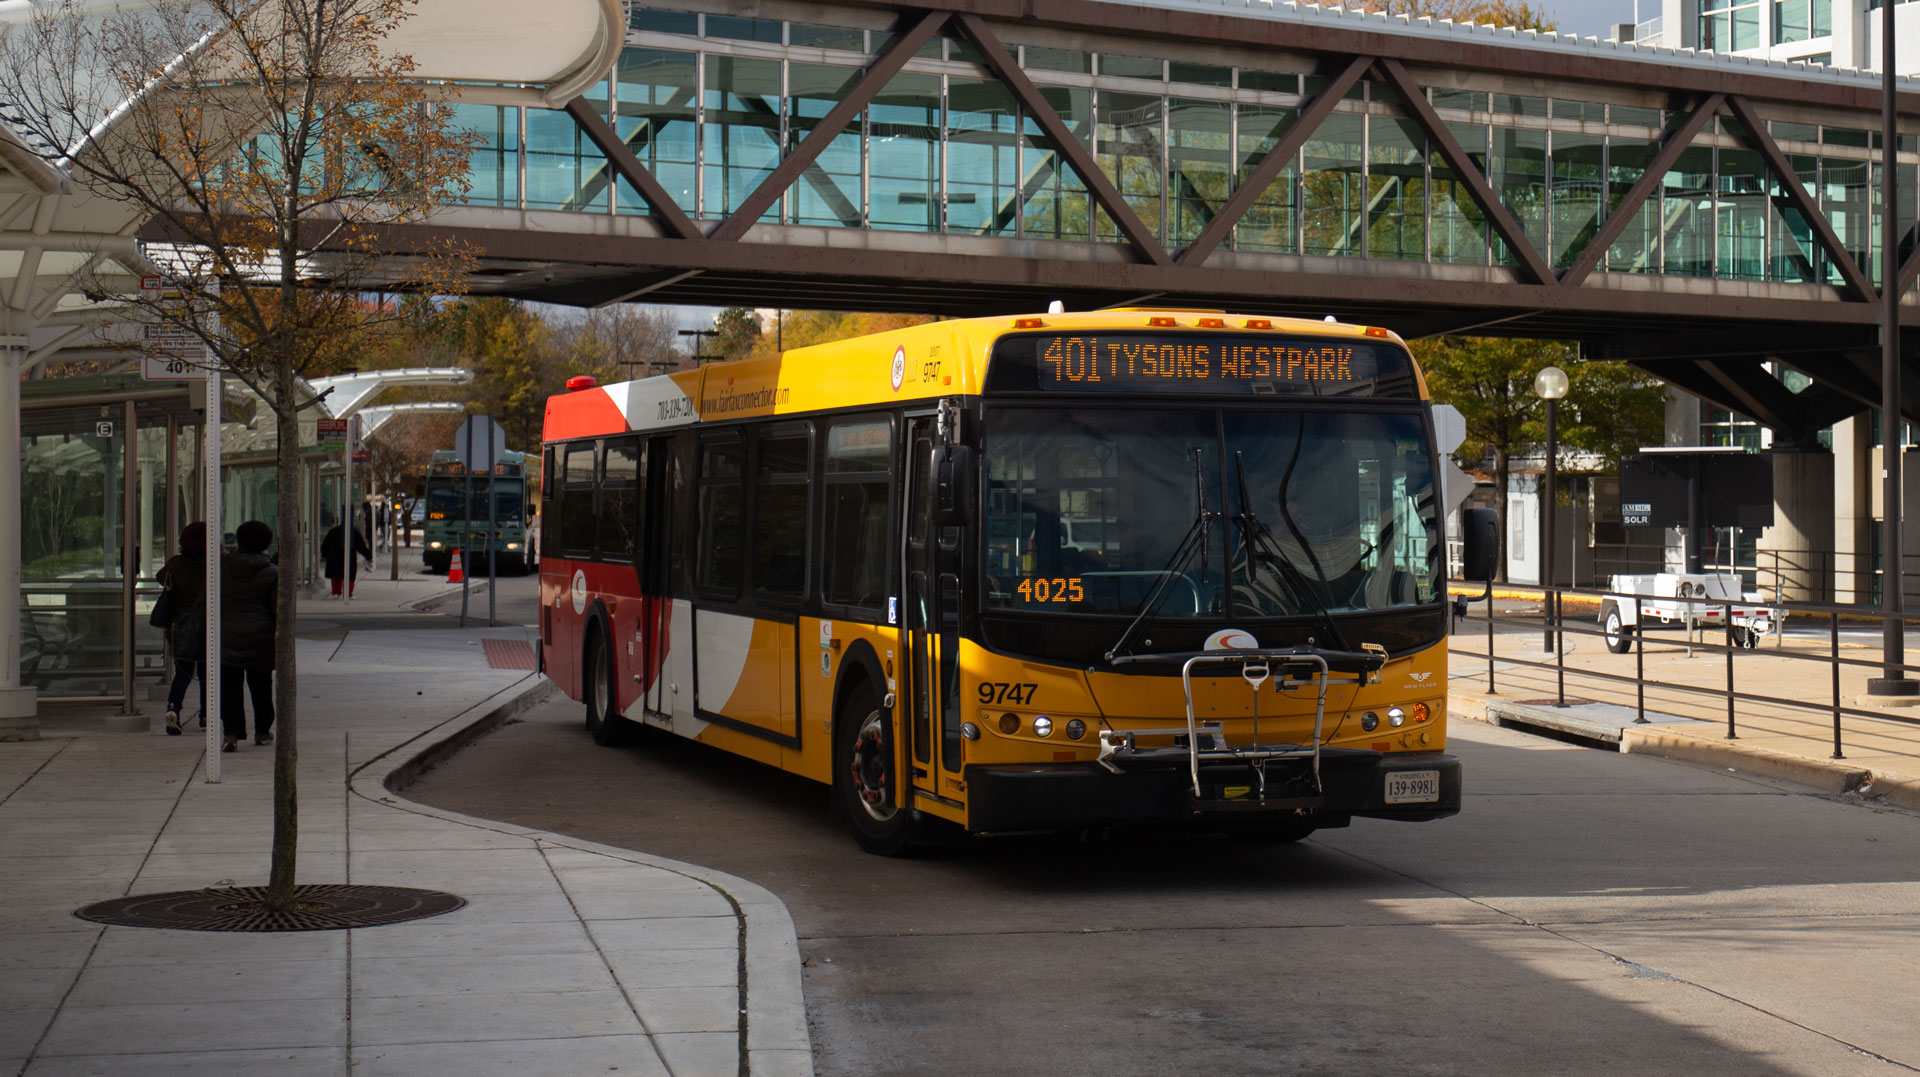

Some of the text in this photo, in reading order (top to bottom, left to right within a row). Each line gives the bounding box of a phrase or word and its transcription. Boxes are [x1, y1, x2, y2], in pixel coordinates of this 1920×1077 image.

[1044, 337, 1353, 381] 401 TYSONS WESTPARK
[923, 361, 941, 383] 9747
[1624, 515, 1648, 524] SOLR
[1017, 578, 1084, 602] 4025
[978, 682, 1038, 704] 9747
